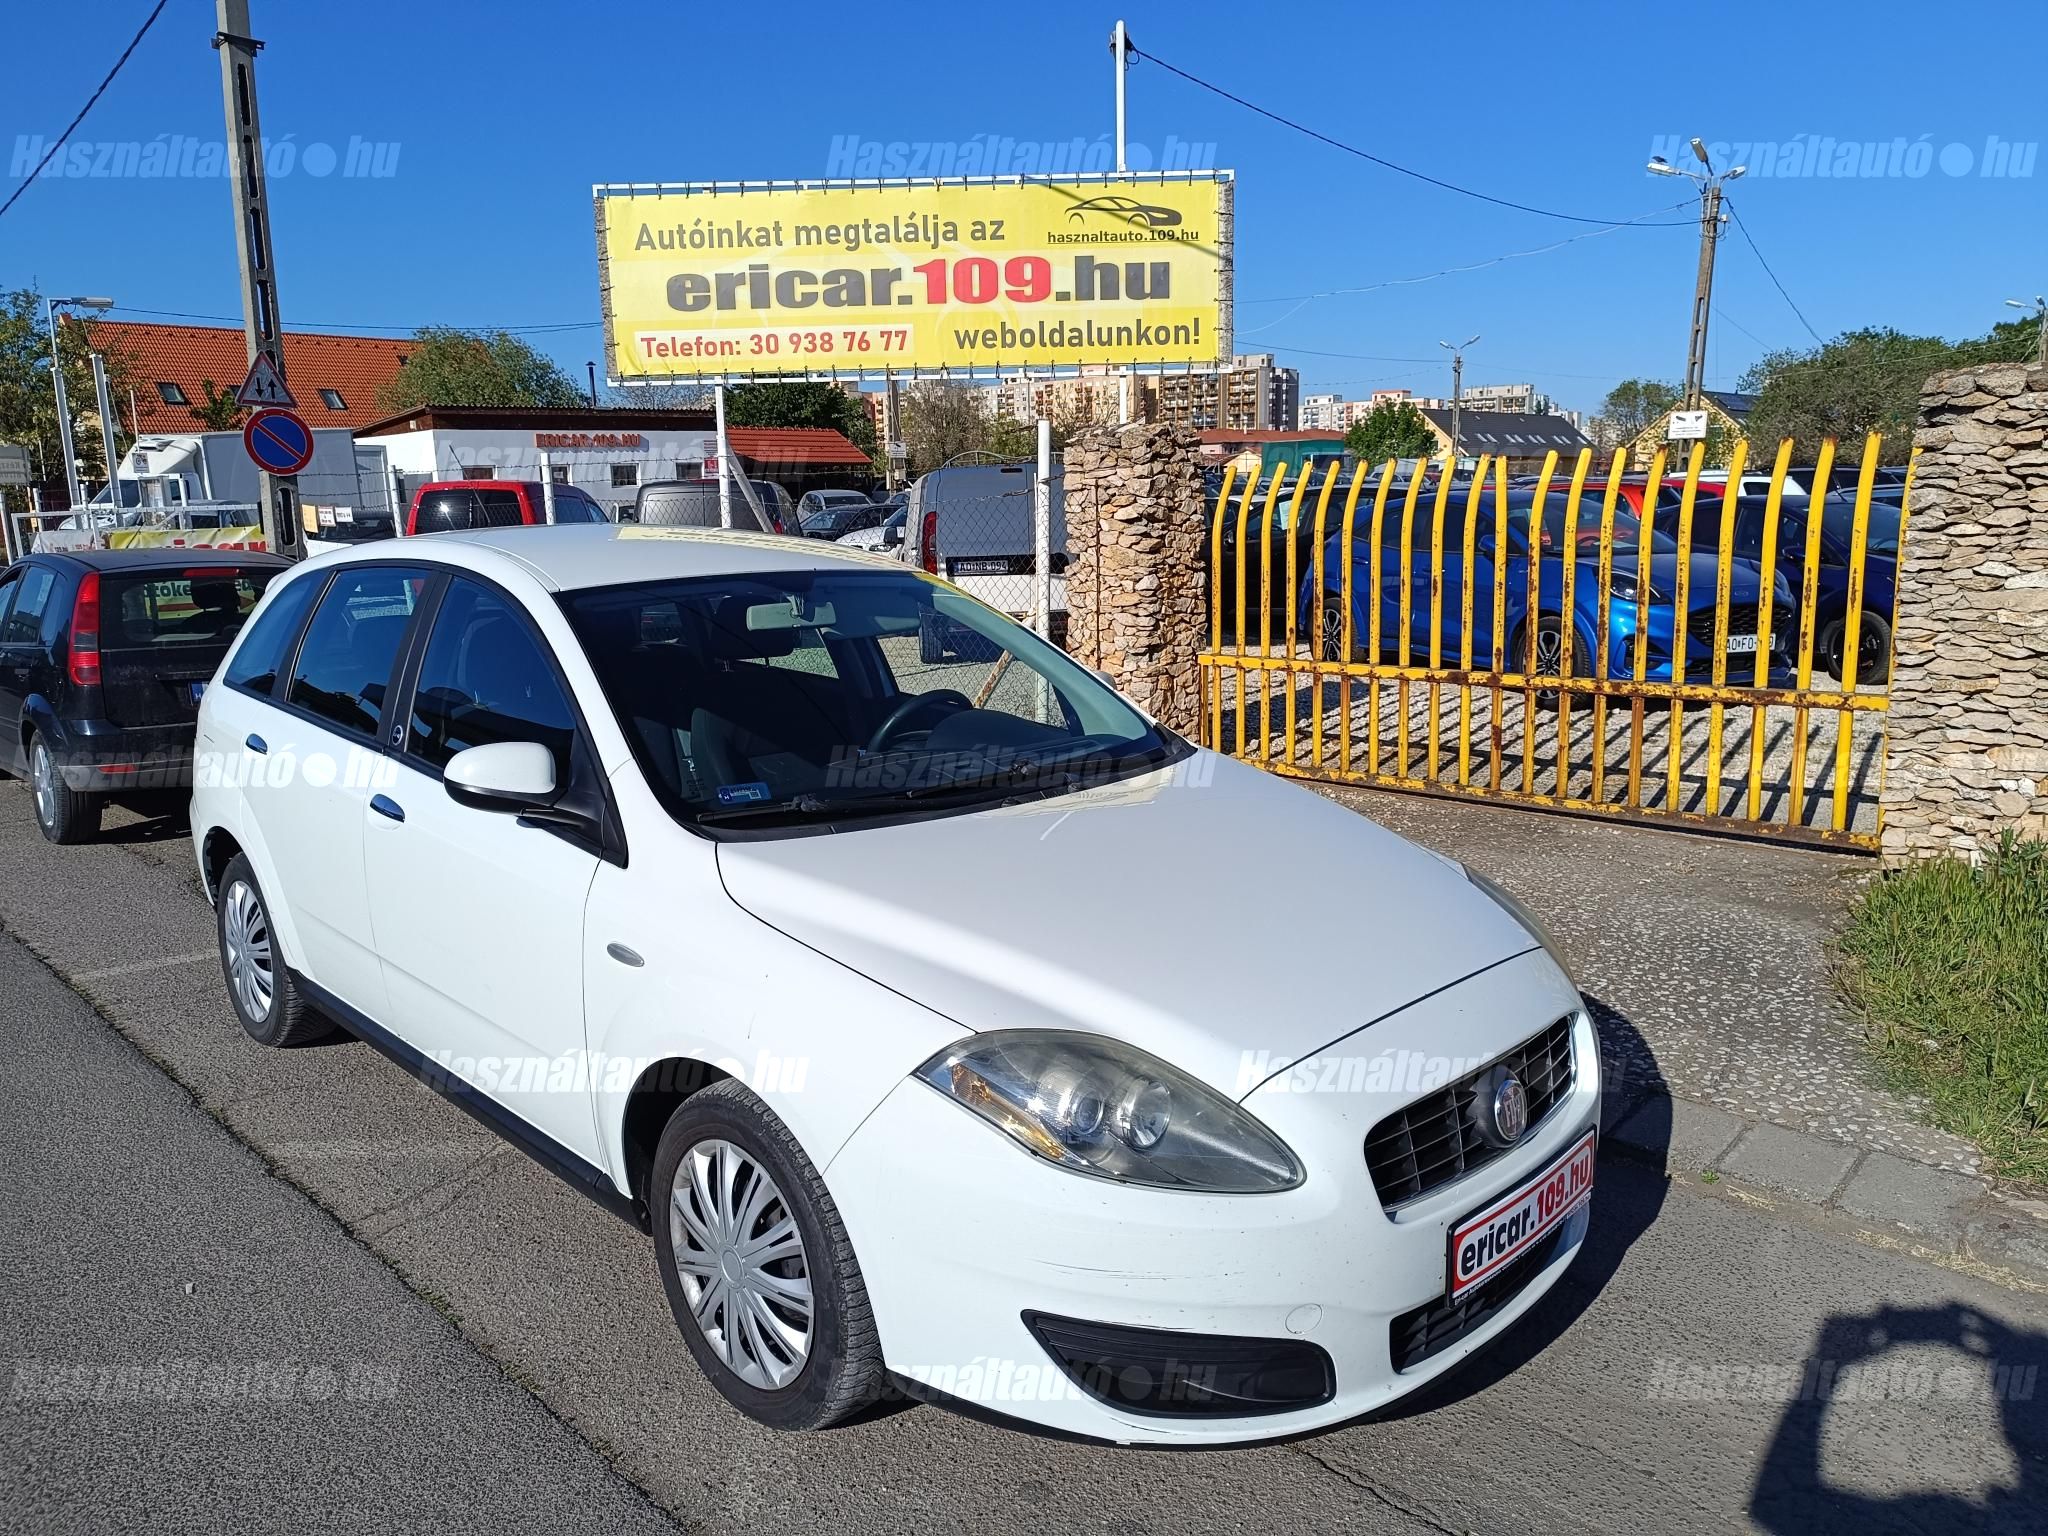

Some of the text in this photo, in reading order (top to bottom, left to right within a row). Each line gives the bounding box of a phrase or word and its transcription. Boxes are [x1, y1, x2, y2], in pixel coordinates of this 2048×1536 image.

[634, 211, 1005, 252] Autóinkat megtalálja az
[1047, 229, 1200, 244] hasznaltauto.109.hu
[666, 255, 1170, 312] ericar.109.hu
[640, 330, 908, 358] Telefon: 30 938 76 77
[954, 317, 1200, 350] weboldalunkon!
[1460, 1153, 1591, 1278] ericar.109.hu
